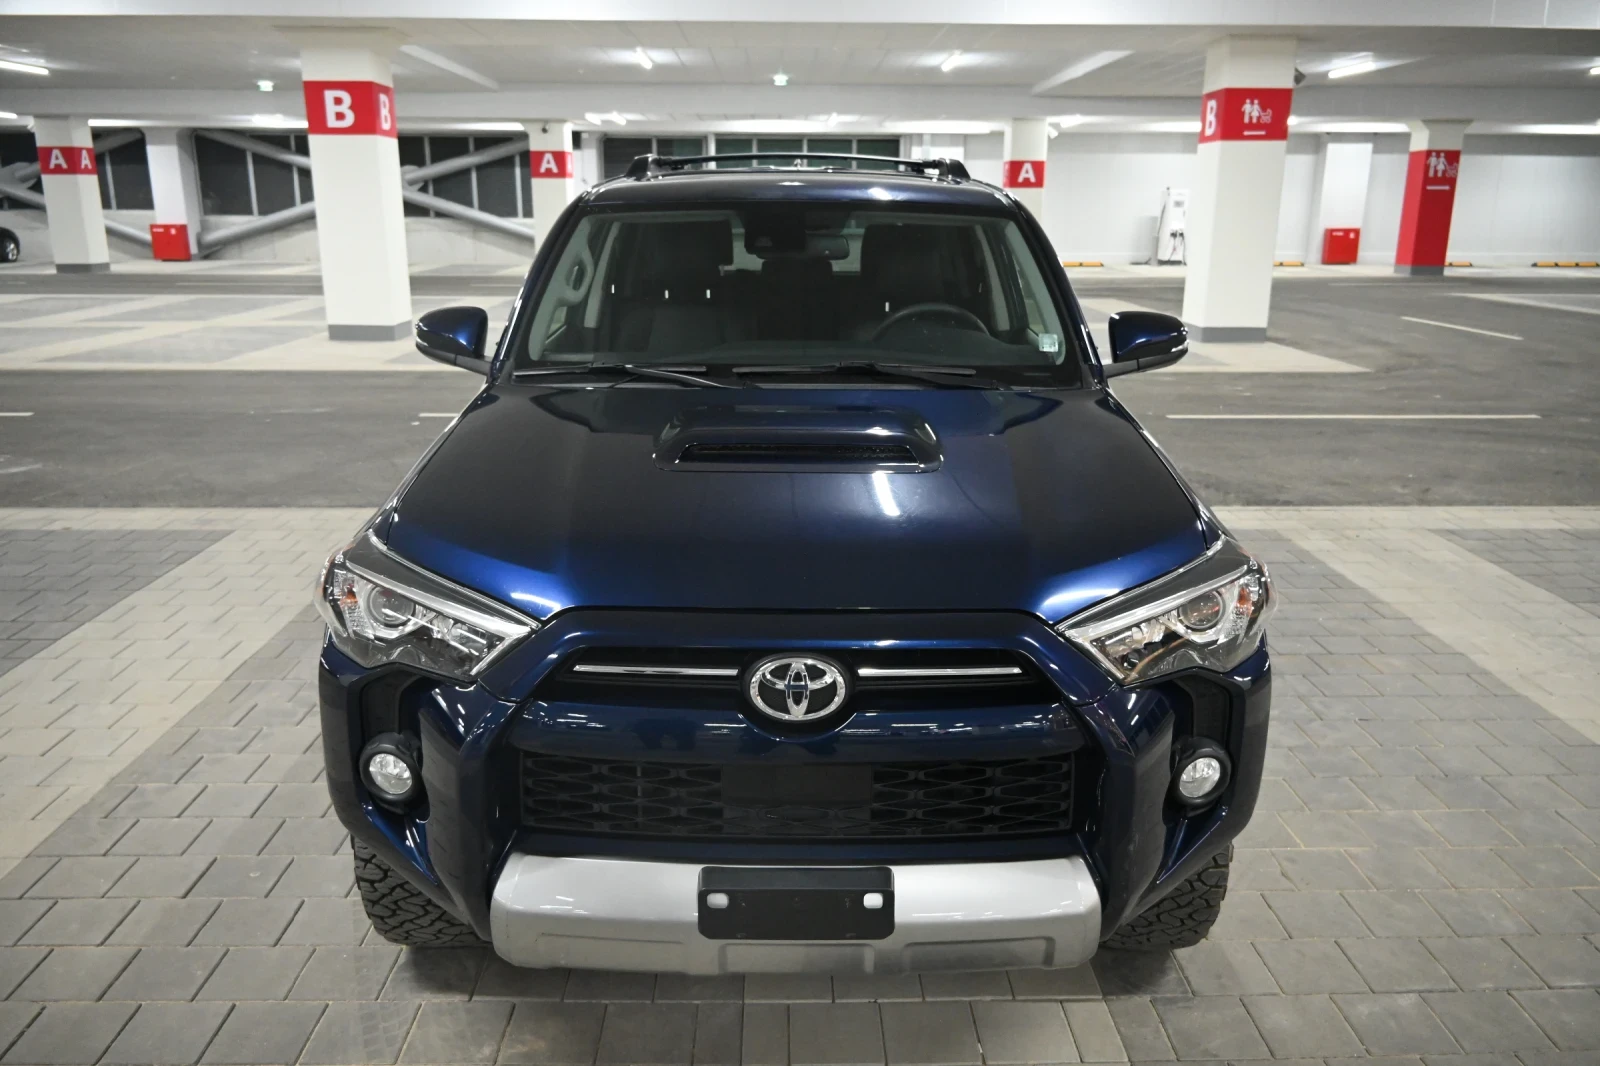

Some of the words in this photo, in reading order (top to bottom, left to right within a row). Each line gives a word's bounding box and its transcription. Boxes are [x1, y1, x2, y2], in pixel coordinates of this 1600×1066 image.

[323, 89, 355, 129] B
[378, 93, 392, 131] B
[1204, 99, 1217, 137] B
[49, 149, 67, 169] A
[81, 149, 92, 170] A
[539, 152, 559, 174] A
[1017, 162, 1037, 183] A
